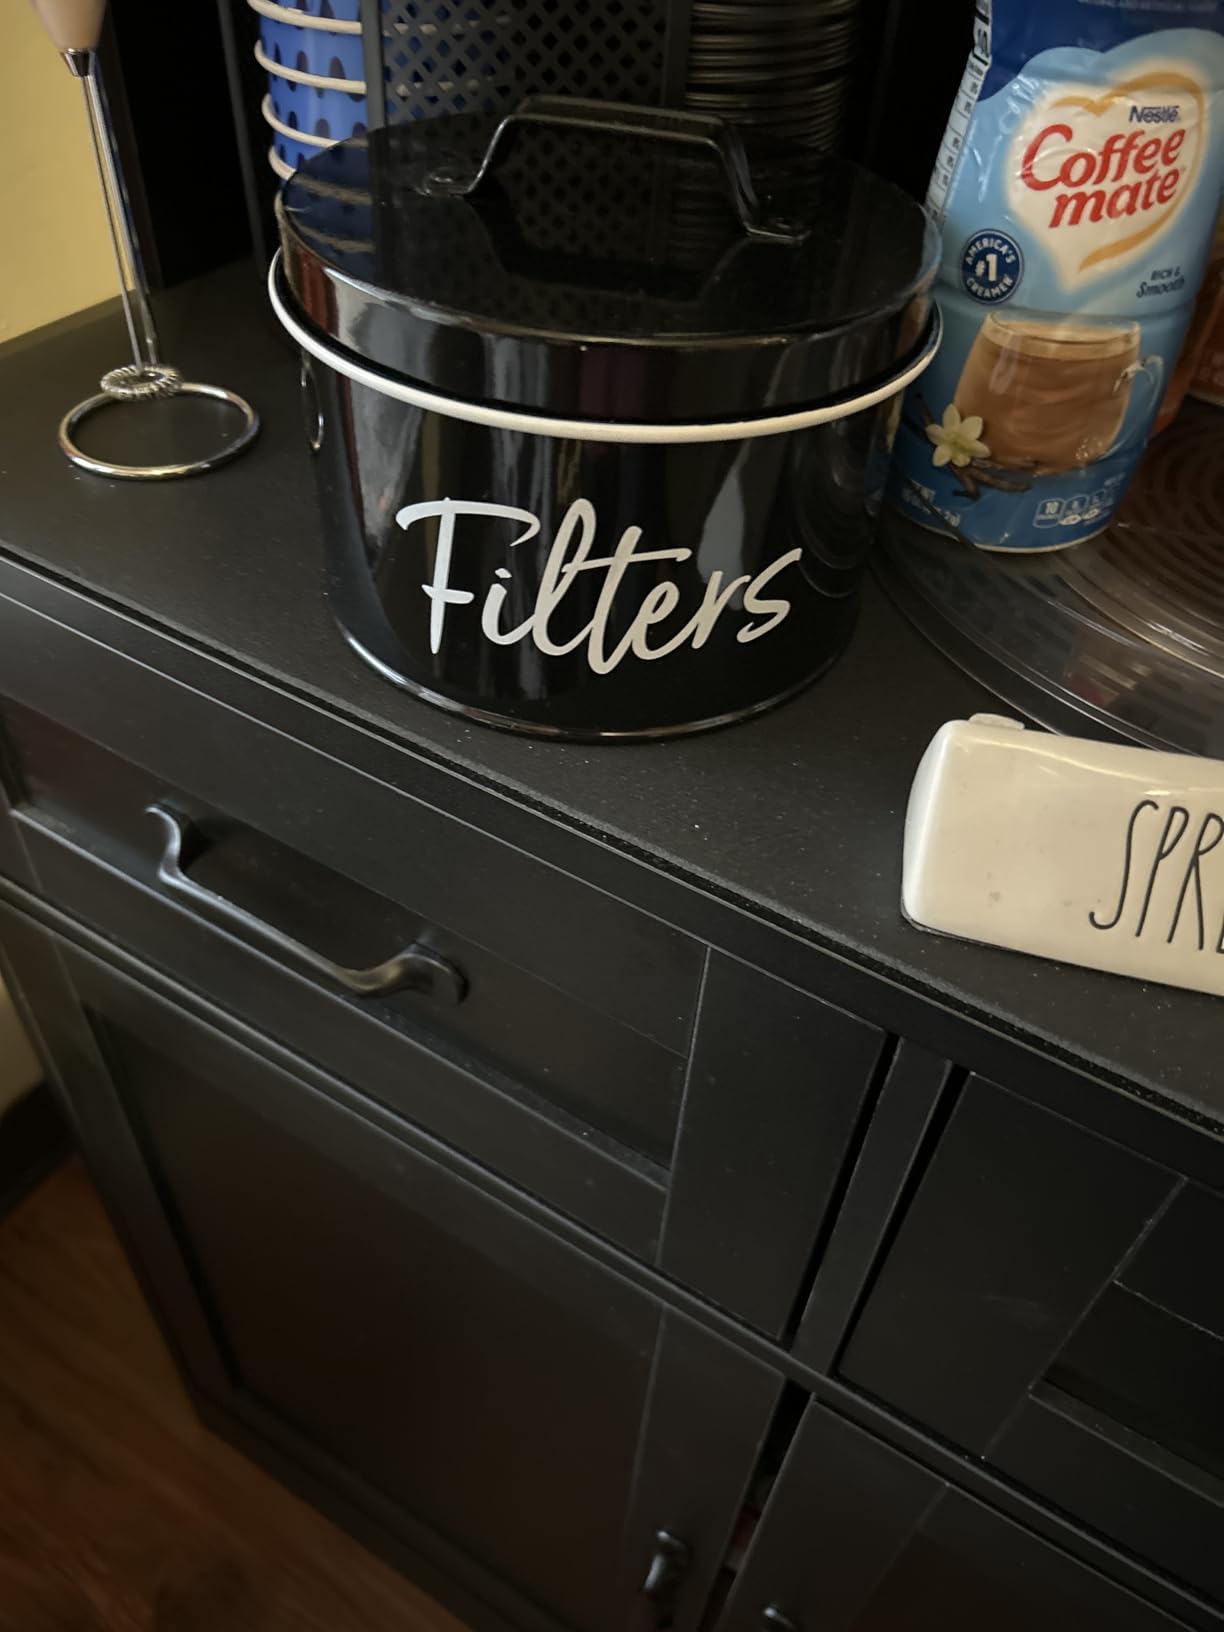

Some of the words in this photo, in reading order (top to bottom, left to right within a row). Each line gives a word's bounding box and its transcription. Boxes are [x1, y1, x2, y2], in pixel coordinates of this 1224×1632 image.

[1018, 124, 1187, 191] Coffee
[1048, 167, 1181, 228] mate
[964, 237, 1017, 266] AMERICA'S
[974, 253, 998, 283] #1
[966, 272, 1014, 299] CREAMER
[395, 496, 803, 676] Filters
